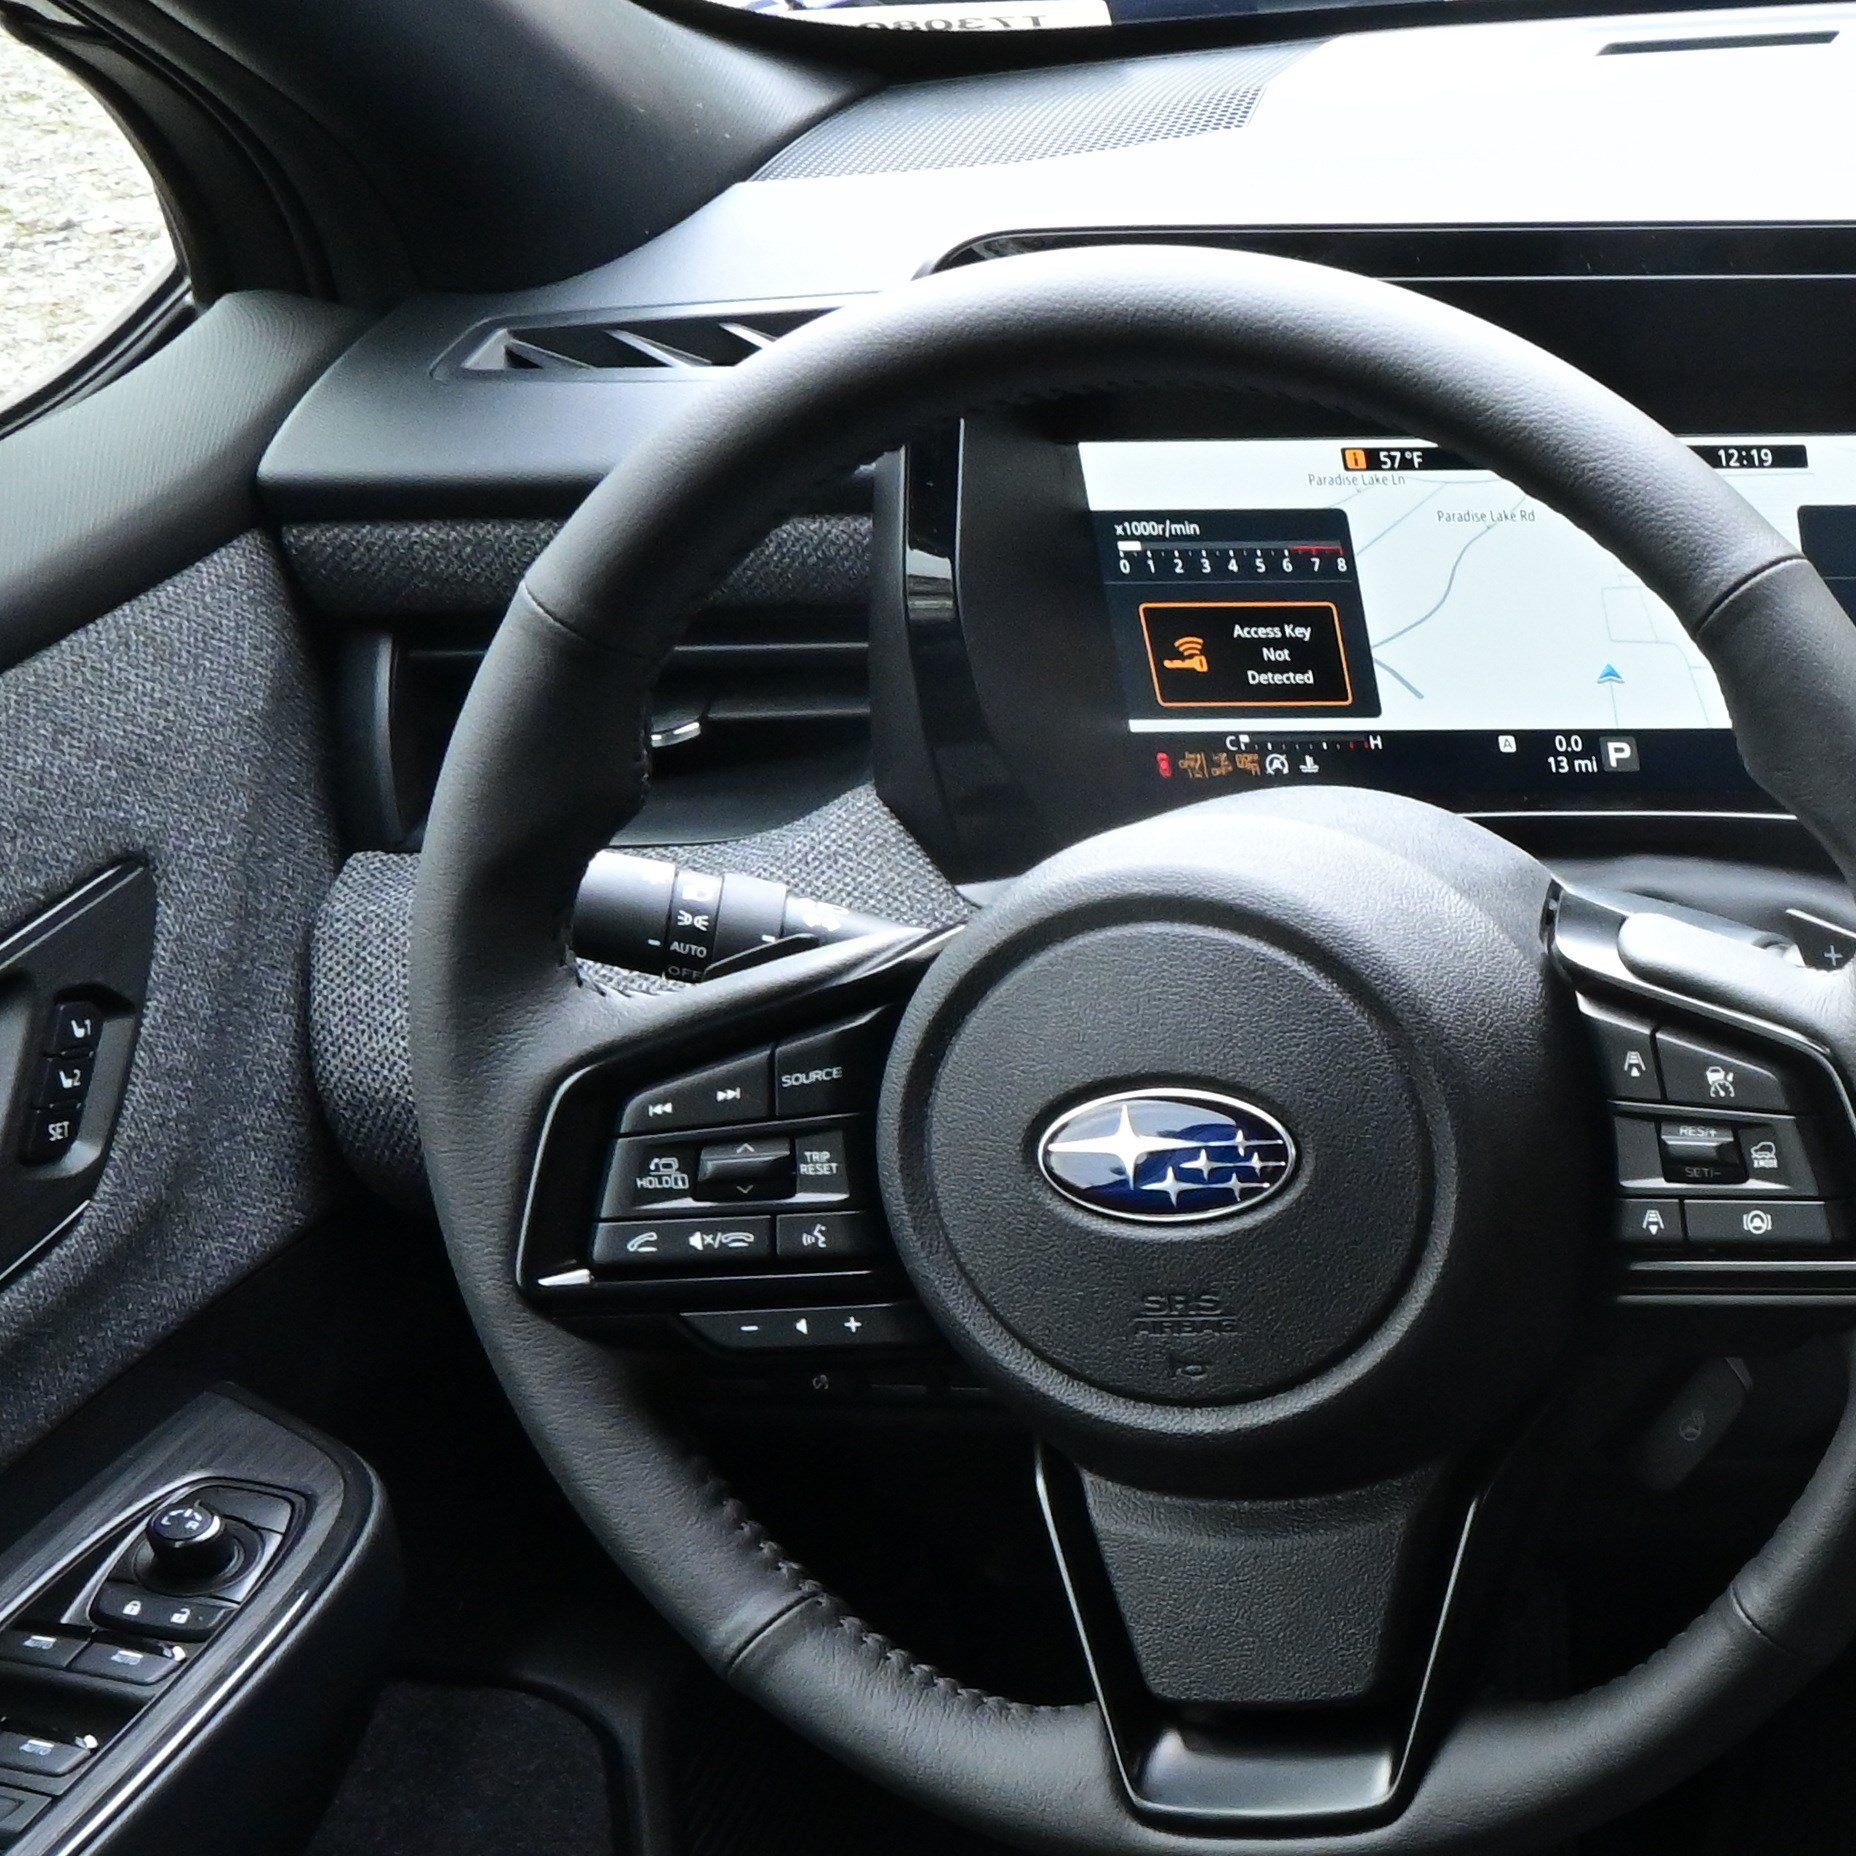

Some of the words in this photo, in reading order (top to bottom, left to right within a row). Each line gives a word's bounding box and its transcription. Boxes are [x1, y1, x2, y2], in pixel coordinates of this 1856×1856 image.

[1380, 451, 1422, 469] 57°F
[1718, 449, 1772, 466] 12:19
[1308, 474, 1358, 486] Paradise
[1361, 474, 1388, 486] Lake
[1437, 510, 1486, 522] Paradise
[1490, 510, 1516, 522] Lake
[1520, 510, 1535, 521] Rd
[1114, 520, 1200, 537] x1000r/min
[1120, 559, 1130, 573] 0
[1147, 559, 1154, 573] 1
[1174, 559, 1184, 573] 2
[1201, 558, 1211, 573] 3
[1228, 559, 1238, 572] 4
[1256, 558, 1265, 572] 5
[1283, 558, 1292, 572] 6
[1311, 558, 1320, 571] 7
[1337, 558, 1347, 572] 8
[1234, 625, 1282, 638] Access
[1284, 624, 1311, 641] Key
[1262, 647, 1291, 661] Not
[1247, 670, 1313, 684] Detected
[1226, 736, 1237, 750] C
[1369, 735, 1382, 749] H
[1555, 735, 1582, 751] 0.0
[1607, 742, 1631, 767] P
[1548, 756, 1569, 773] 13
[1574, 756, 1597, 772] mi
[668, 939, 708, 959] AUTO
[782, 1067, 842, 1087] SOURCE
[48, 1121, 70, 1142] SET
[803, 1151, 832, 1164] TRIP
[799, 1162, 839, 1176] RESET
[636, 1175, 672, 1190] HOLD
